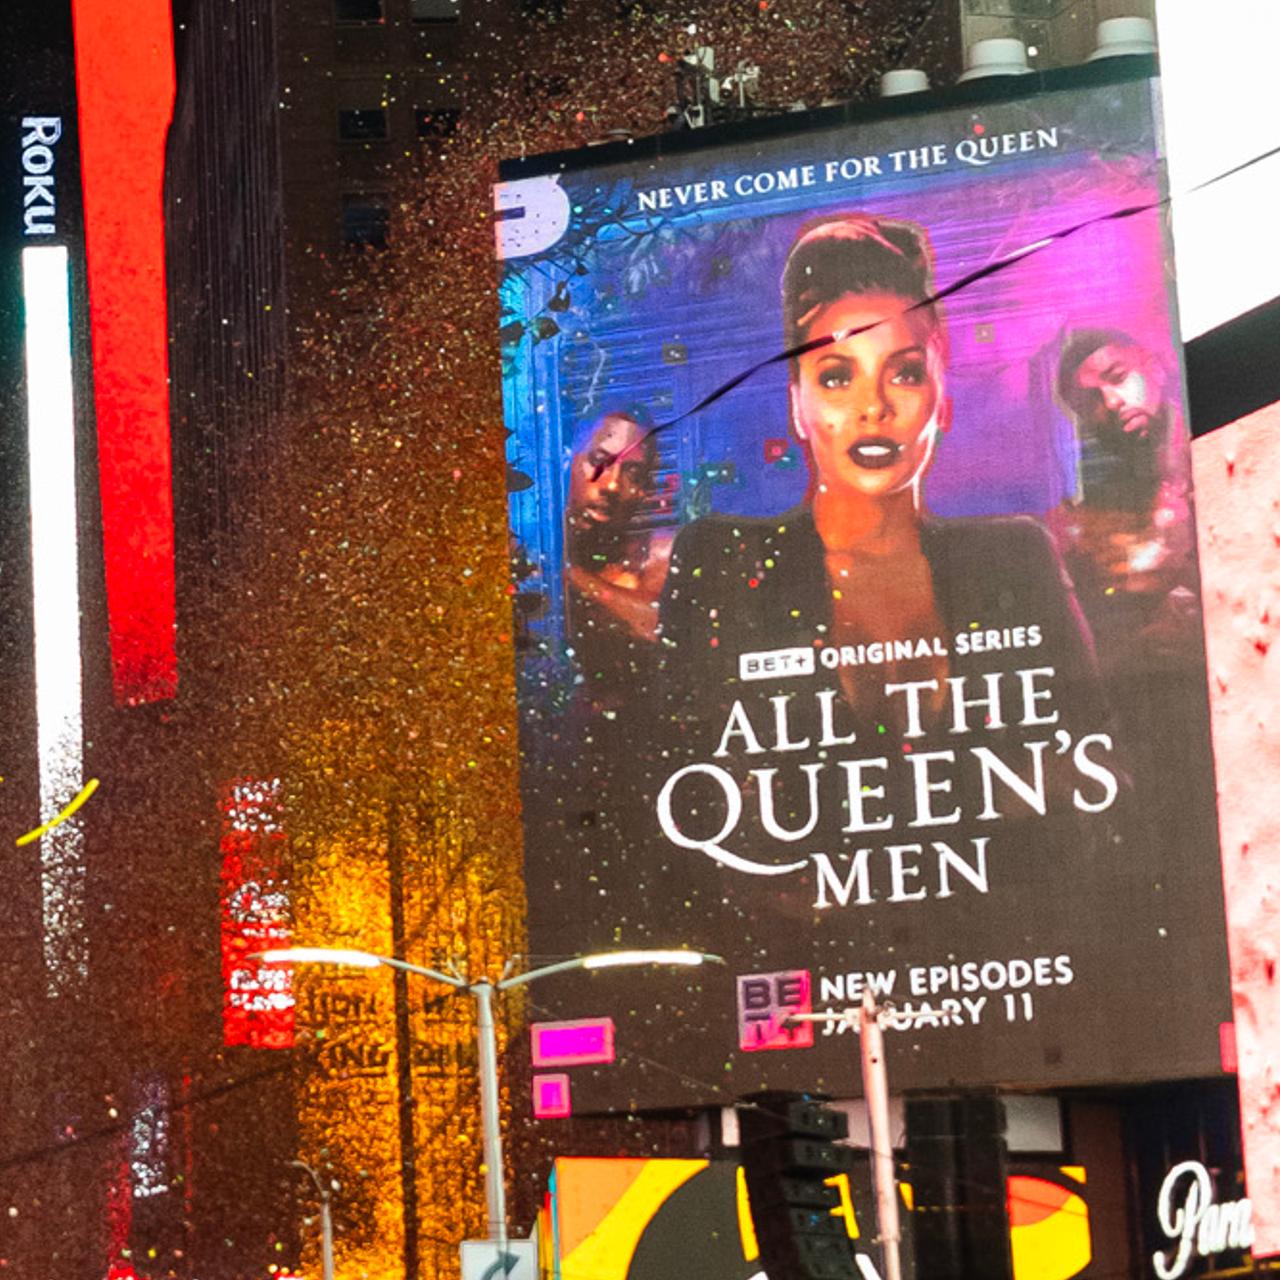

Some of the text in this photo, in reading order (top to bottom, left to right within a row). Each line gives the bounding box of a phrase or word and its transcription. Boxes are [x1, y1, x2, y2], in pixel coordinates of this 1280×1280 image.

[639, 126, 1059, 211] NEVER COME FOR THE QUEEN
[820, 637, 948, 669] ORIGINAL
[955, 625, 1043, 656] SERIES
[713, 666, 1059, 758] ALL THE
[656, 729, 1119, 875] QUEEN'S
[810, 837, 991, 910] MEN
[820, 955, 1074, 1002] NEW EPISODES
[822, 992, 1034, 1036] JAUARY 11
